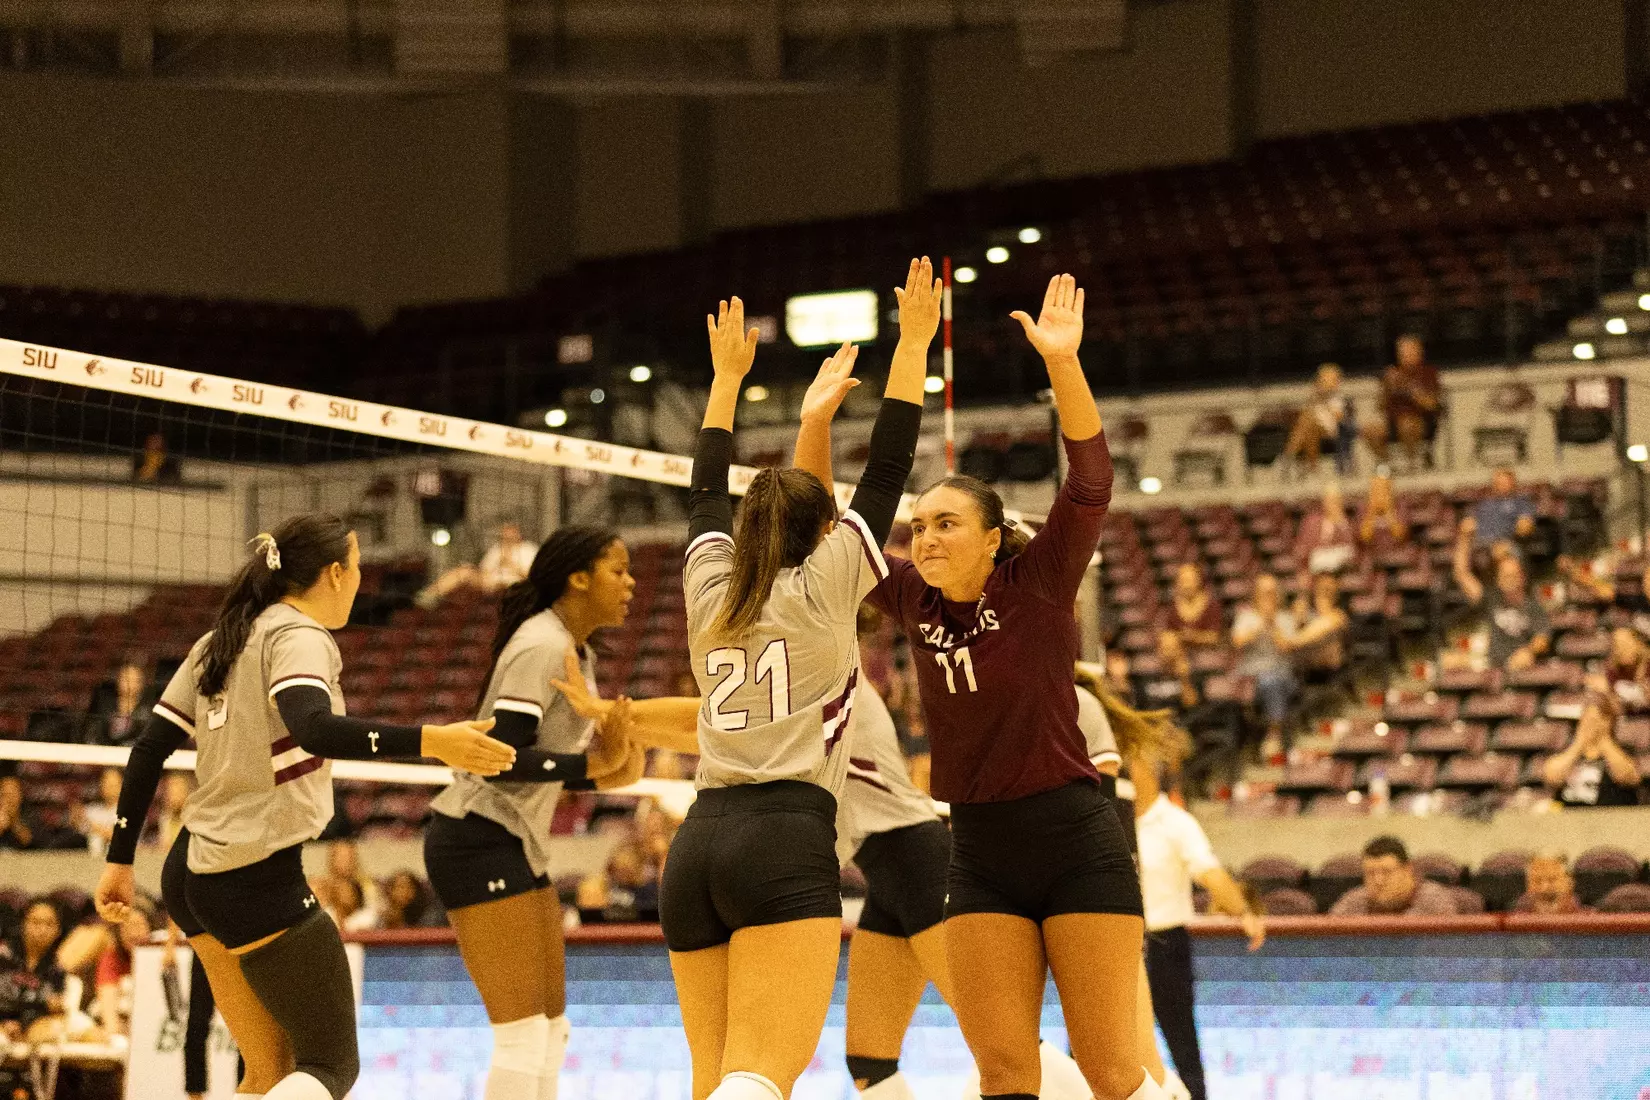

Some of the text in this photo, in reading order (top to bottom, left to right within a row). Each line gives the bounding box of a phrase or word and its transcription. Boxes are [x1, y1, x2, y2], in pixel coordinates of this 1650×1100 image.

[23, 347, 58, 370] SIU
[130, 367, 164, 388] SIU
[231, 384, 264, 406] SIU
[328, 401, 358, 422] SIU
[419, 417, 447, 437] SIU
[505, 430, 533, 449] SIU
[919, 609, 1000, 649] SALIS
[706, 638, 792, 731] 21
[935, 646, 978, 693] 11
